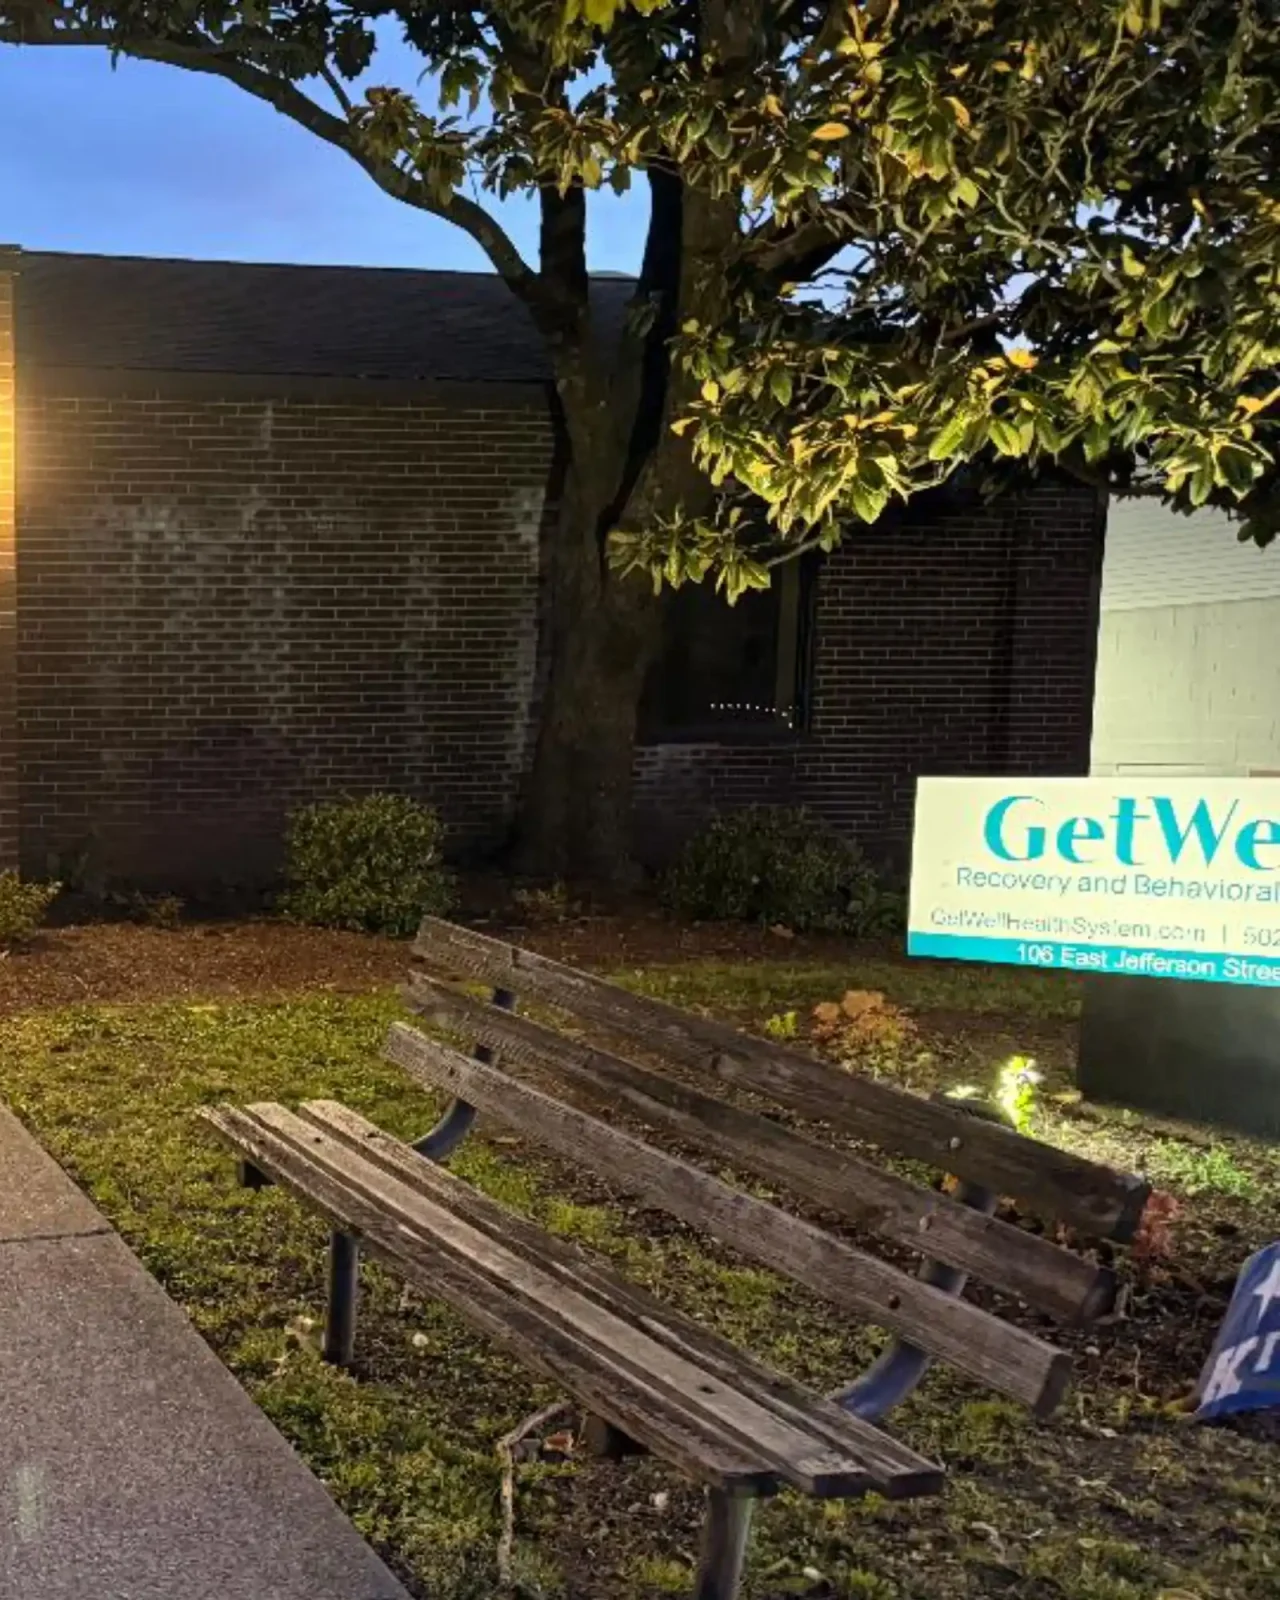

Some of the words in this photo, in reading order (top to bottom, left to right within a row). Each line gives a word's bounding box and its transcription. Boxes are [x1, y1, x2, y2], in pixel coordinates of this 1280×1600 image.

[983, 795, 1280, 871] GetWe
[956, 867, 1072, 896] Recovery
[1078, 872, 1128, 895] and
[1133, 873, 1280, 903] Behavioral
[1017, 943, 1054, 964] 106
[1060, 947, 1108, 969] East
[1114, 950, 1217, 977] Jefferson
[1222, 957, 1280, 982] Stree
